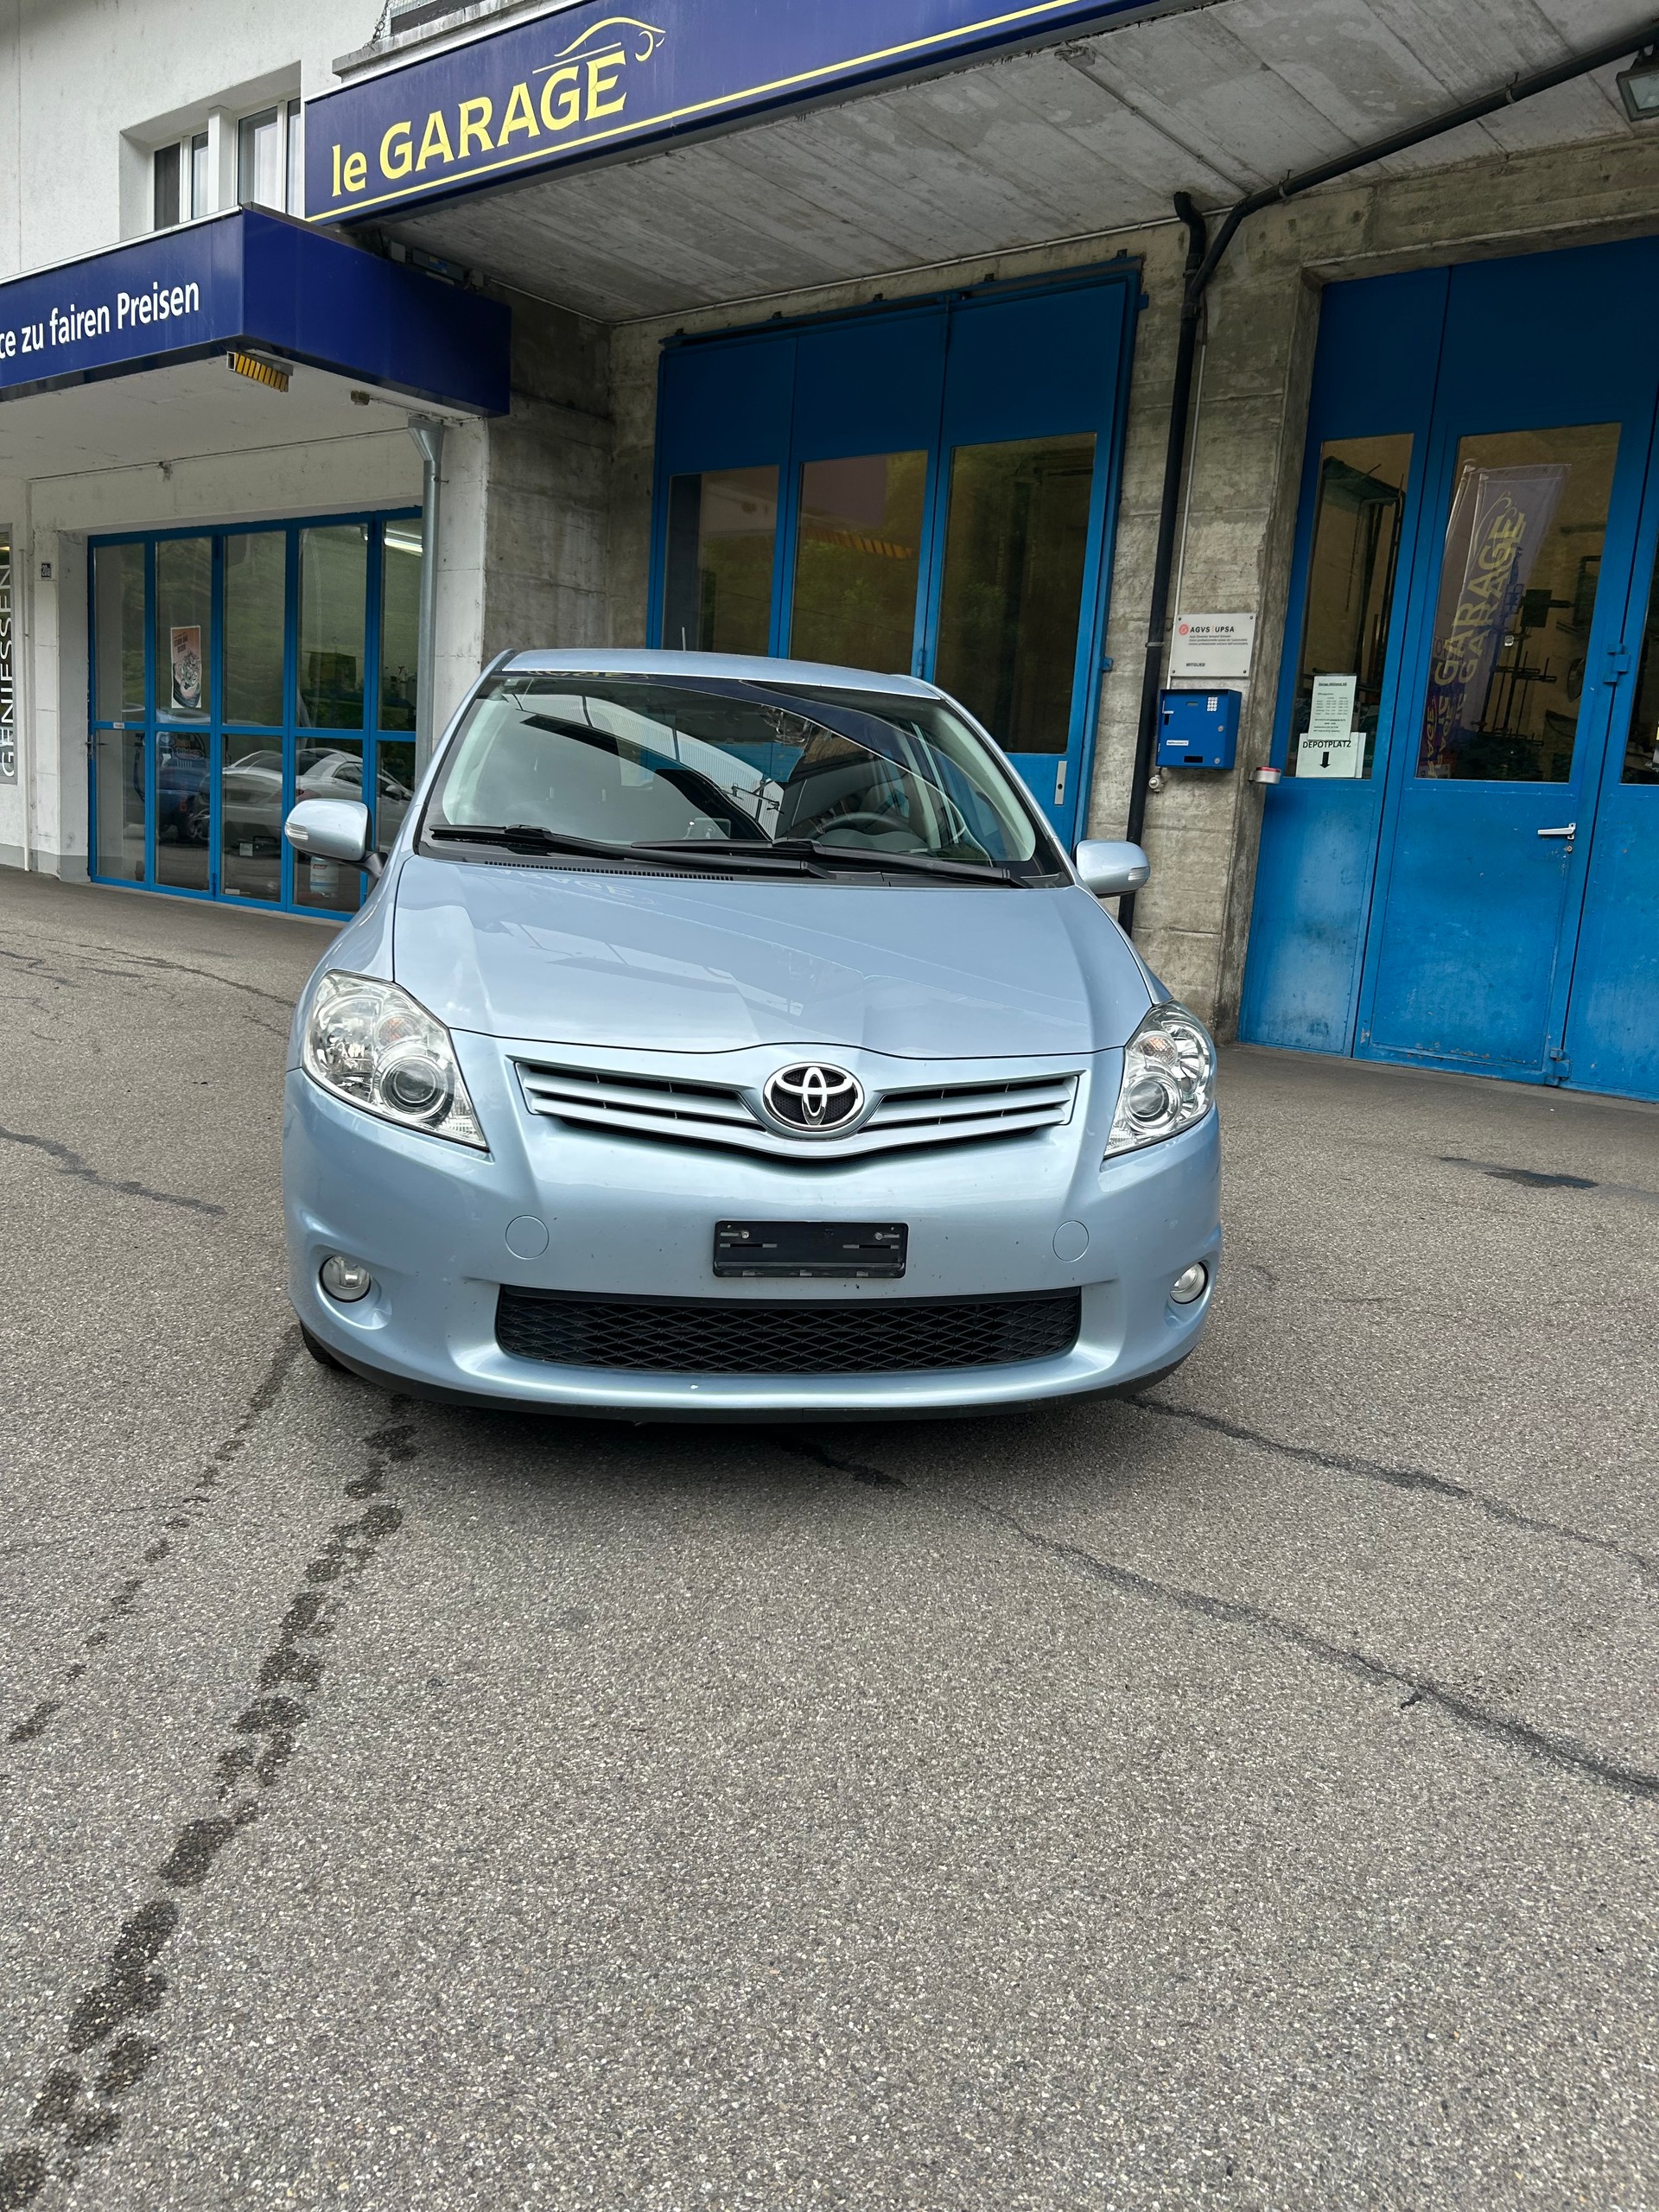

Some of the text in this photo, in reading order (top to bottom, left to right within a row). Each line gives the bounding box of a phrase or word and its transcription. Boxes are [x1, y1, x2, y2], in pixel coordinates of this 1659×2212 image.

[332, 50, 627, 197] le GARAGE
[22, 323, 44, 353] zu
[49, 303, 111, 346] fairen
[117, 282, 200, 330] Preisen
[0, 564, 14, 777] GENIESSEN
[1302, 740, 1351, 748] DEPOTPLATZ
